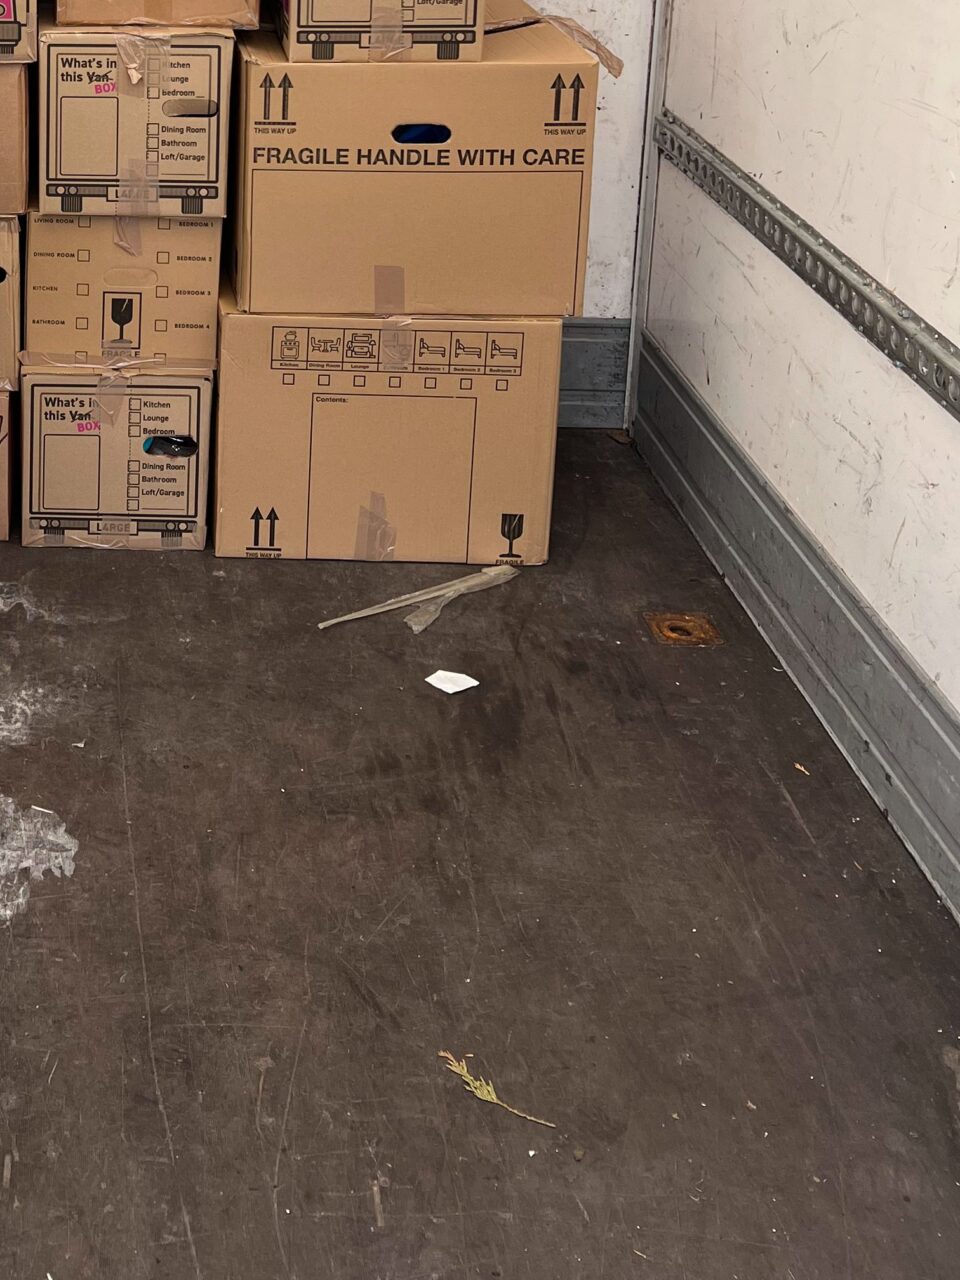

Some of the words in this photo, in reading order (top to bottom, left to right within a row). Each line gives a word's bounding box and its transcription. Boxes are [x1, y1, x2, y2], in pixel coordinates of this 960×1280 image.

[60, 57, 103, 69] What's
[106, 57, 117, 69] in
[60, 71, 83, 82] this
[86, 71, 112, 84] Van
[94, 82, 117, 94] BOX
[161, 126, 184, 134] Dining
[286, 127, 297, 135] UP
[160, 153, 206, 162] Loft/Garage
[252, 147, 350, 166] FRAGILE
[356, 148, 450, 166] HANDLE
[457, 148, 515, 166] WITH
[522, 148, 585, 166] CARE
[44, 397, 85, 408] What's
[143, 401, 171, 409] Kitchen
[44, 410, 66, 421] this
[69, 410, 92, 422] Van
[142, 414, 169, 423] Lounge
[77, 420, 101, 433] BOX
[142, 427, 175, 435] Bedroom
[142, 463, 164, 471] Dining
[166, 463, 186, 471] Room
[141, 488, 185, 497] Loft/Garage
[96, 522, 131, 532] LARGE
